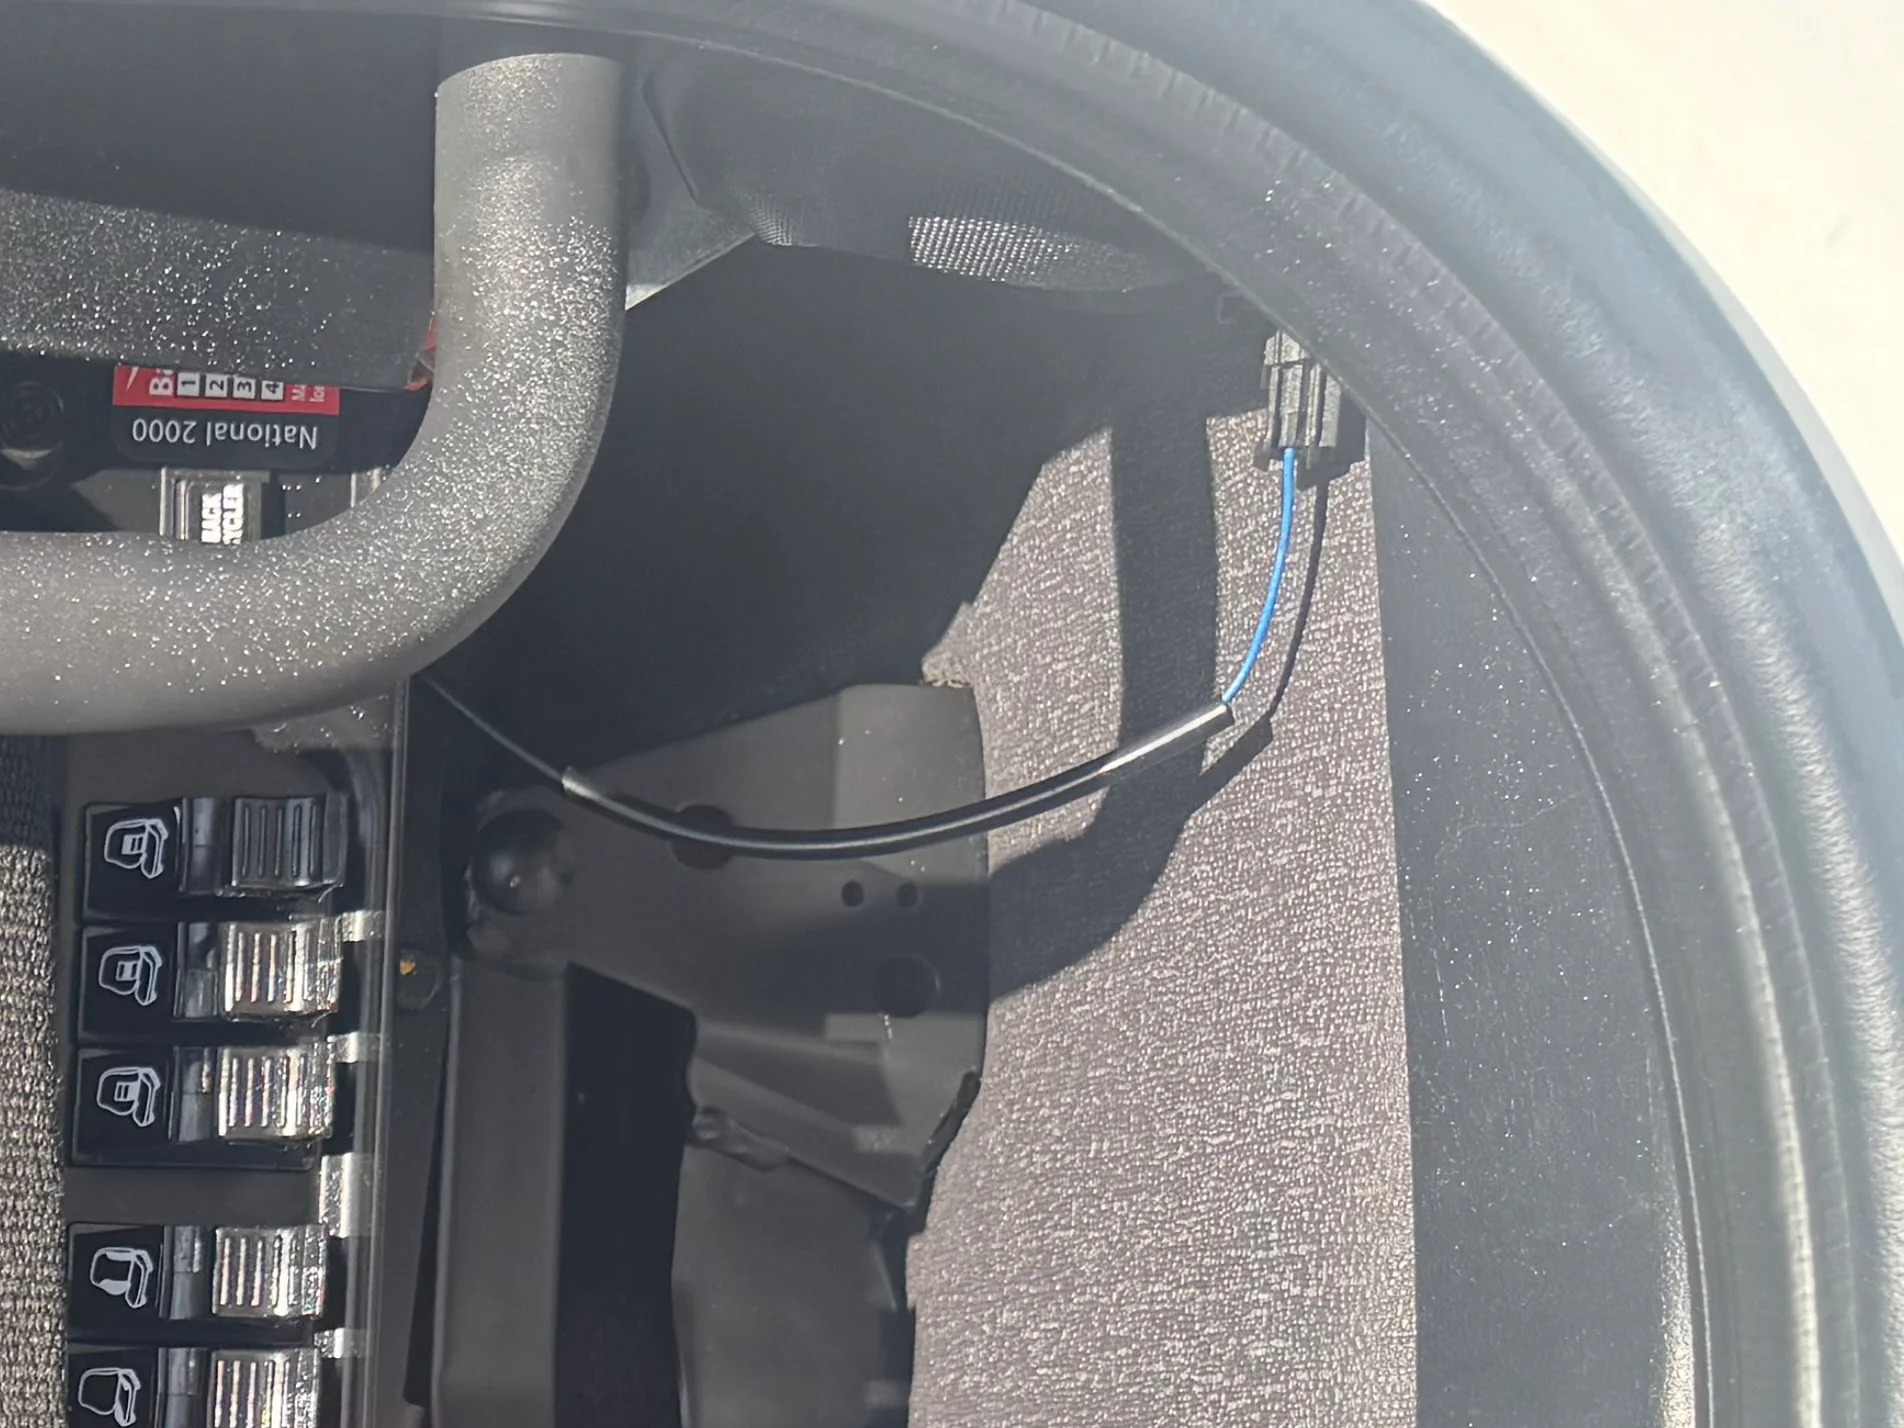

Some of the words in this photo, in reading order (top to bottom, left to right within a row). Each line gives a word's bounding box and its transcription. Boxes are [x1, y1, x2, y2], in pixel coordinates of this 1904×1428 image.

[210, 379, 224, 391] 2
[238, 381, 252, 392] 3
[265, 382, 280, 395] 4
[132, 418, 197, 444] 2000
[206, 420, 318, 450] National
[201, 492, 222, 543] BACK
